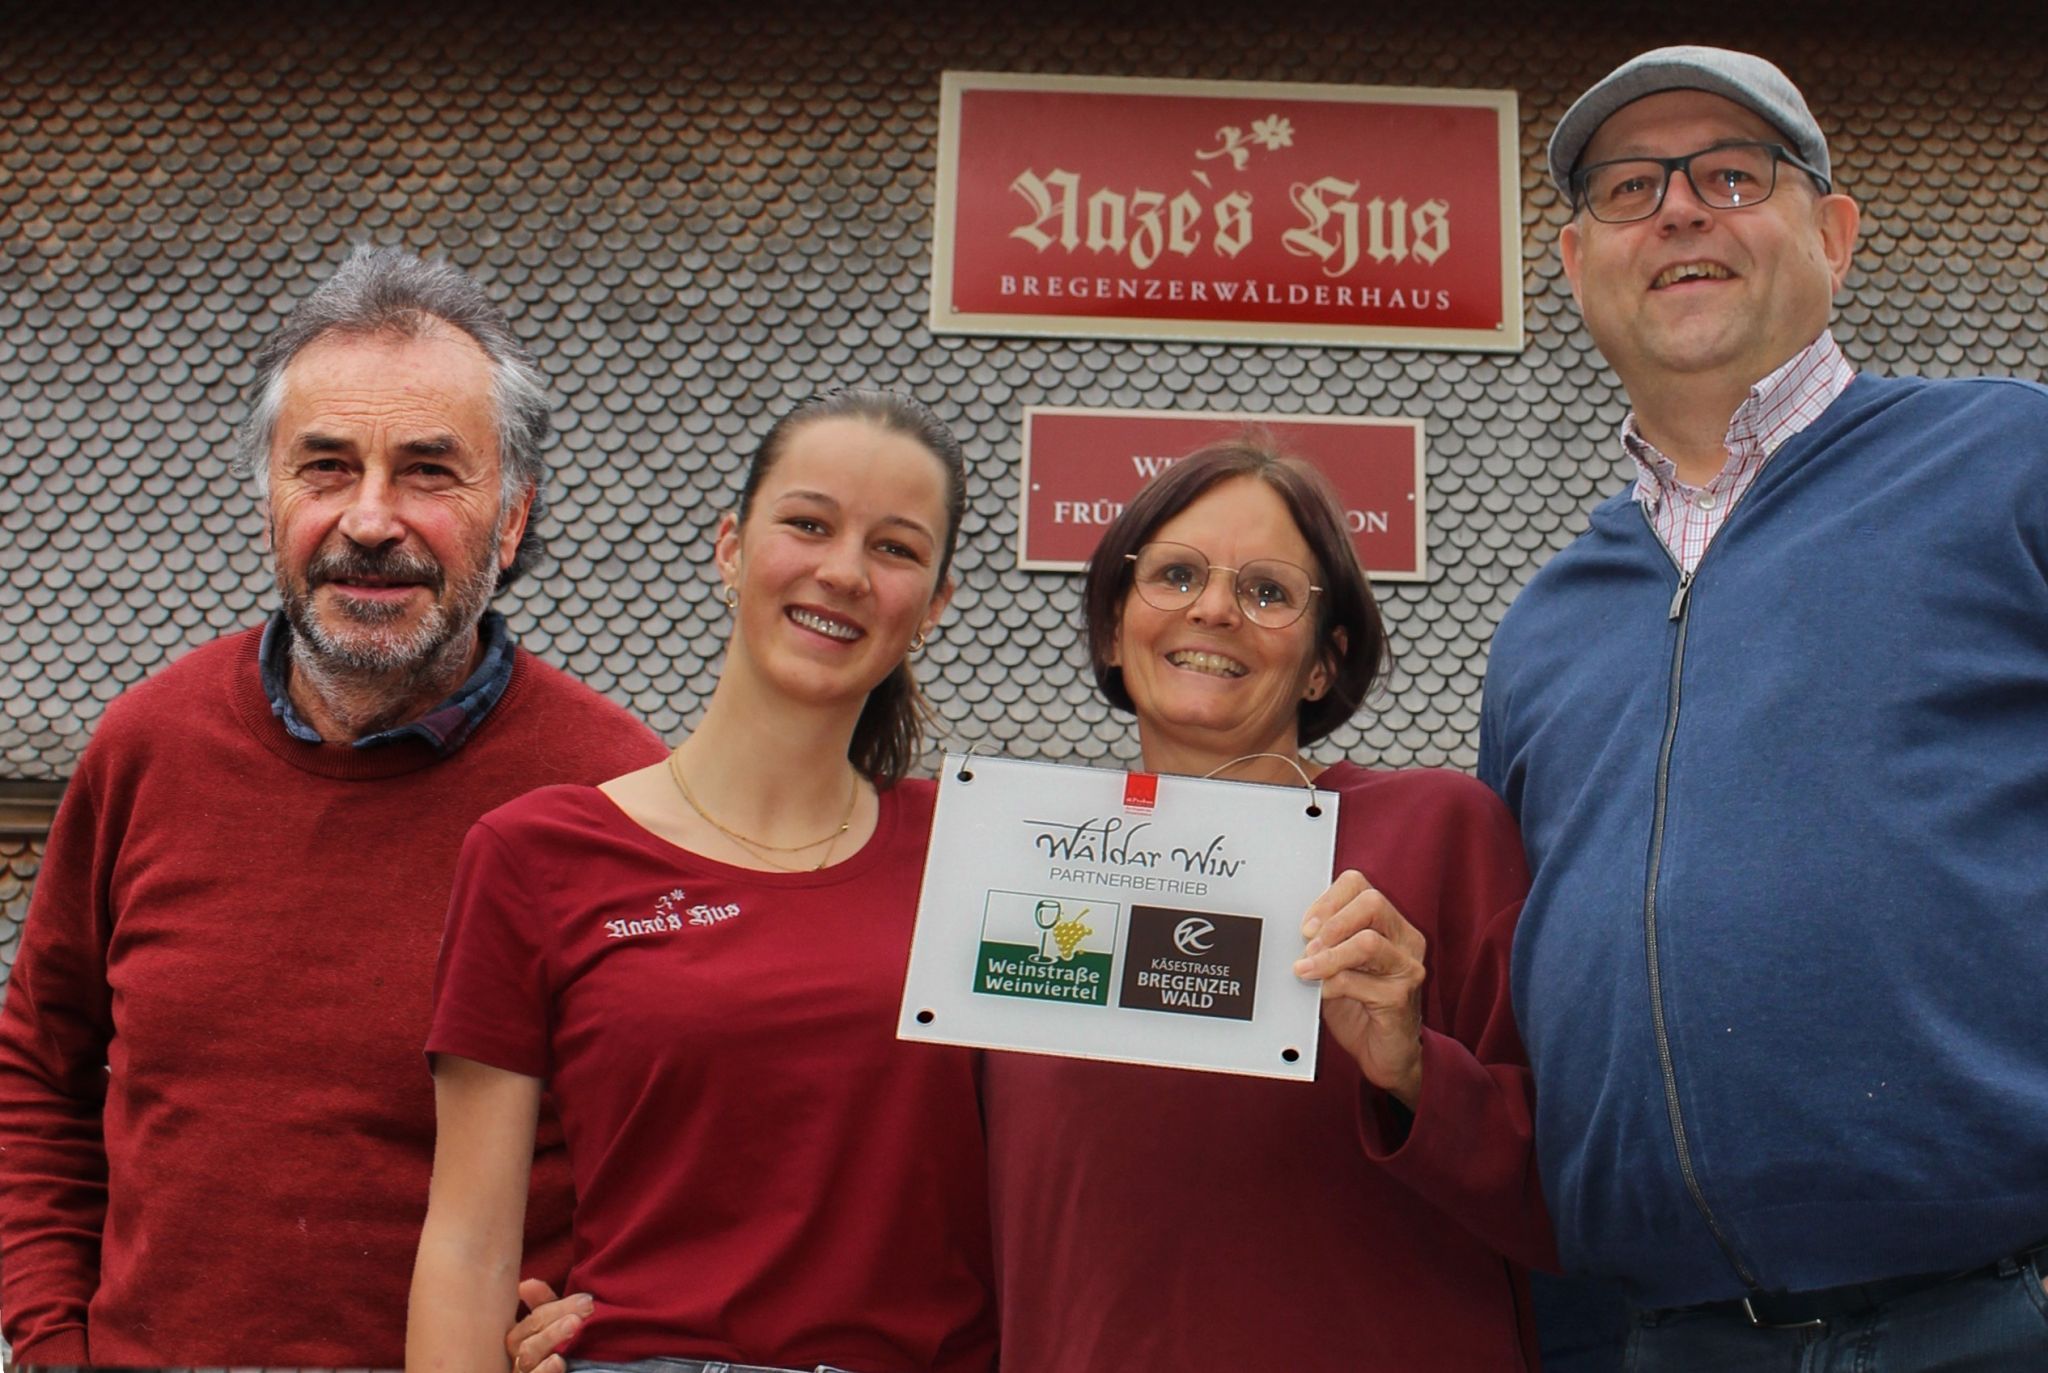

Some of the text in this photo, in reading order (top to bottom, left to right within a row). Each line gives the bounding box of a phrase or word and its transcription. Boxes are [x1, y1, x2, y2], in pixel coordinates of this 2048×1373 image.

[1281, 175, 1451, 276] Hus
[1000, 274, 1452, 311] BREGENZERWÄLDERHAUS
[1049, 867, 1209, 896] PARTNERBETRIEB
[686, 903, 741, 926] Hus
[988, 958, 1100, 985] Weinstraße
[1151, 957, 1231, 977] KÄSESTRASSE
[985, 974, 1098, 1001] Weinviertel
[1137, 971, 1241, 997] BREGENZER
[1161, 990, 1214, 1009] WALD
